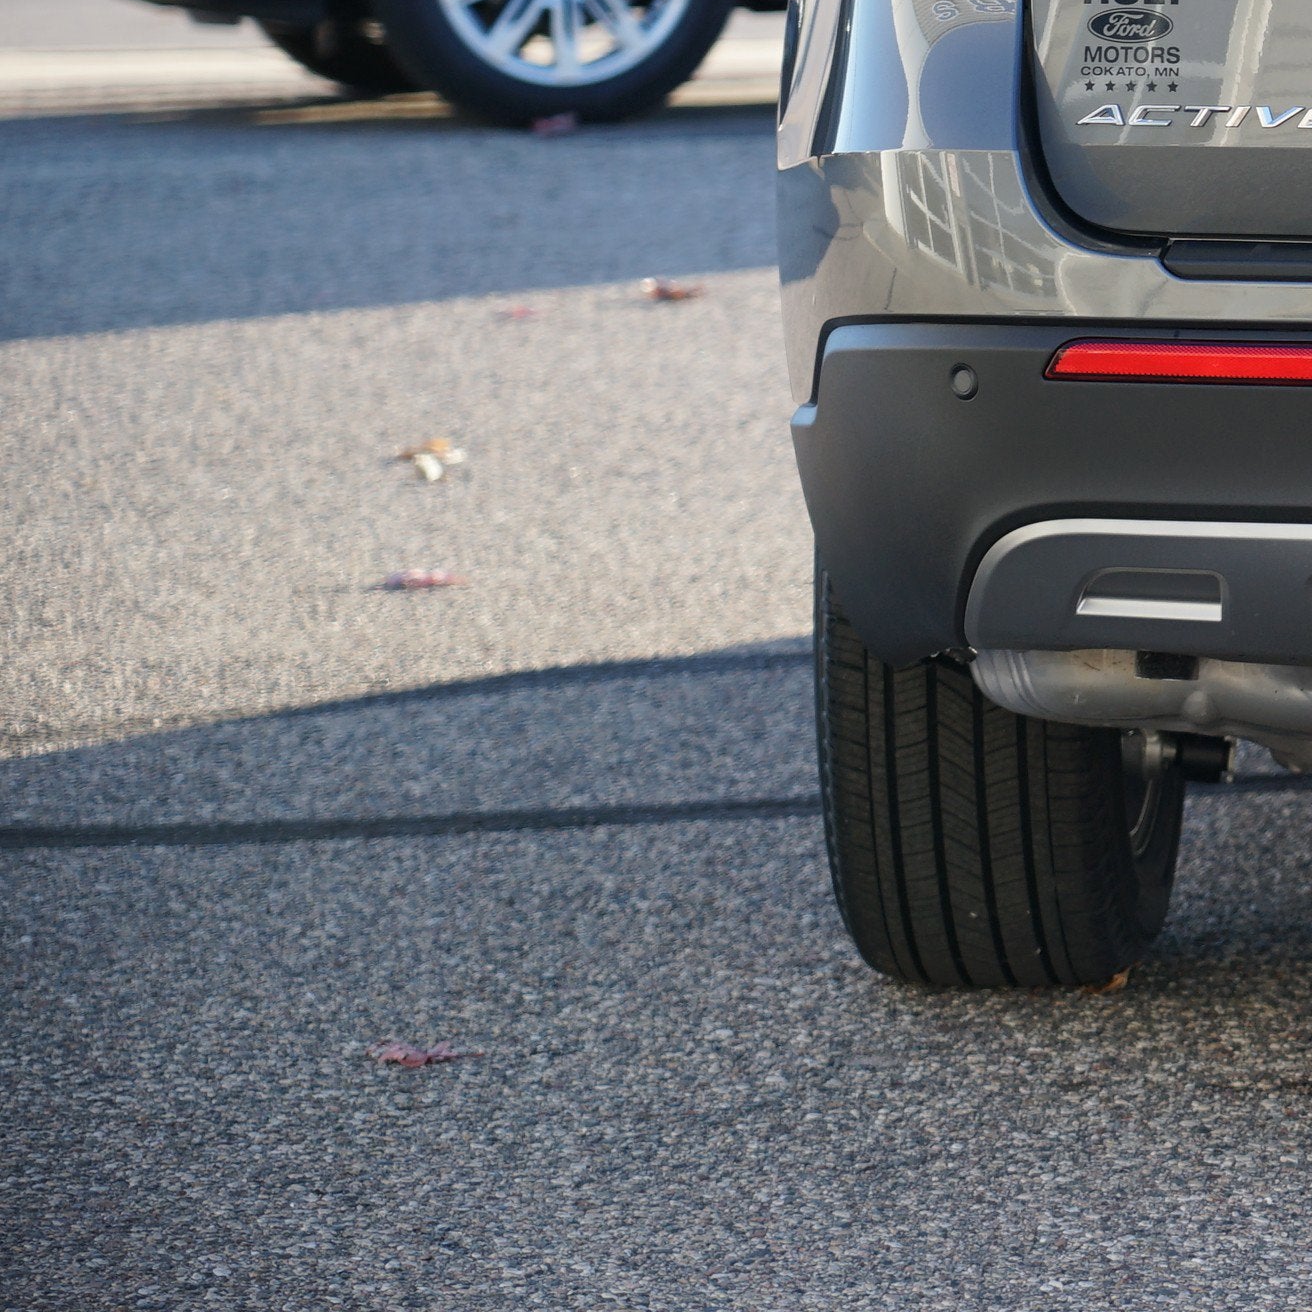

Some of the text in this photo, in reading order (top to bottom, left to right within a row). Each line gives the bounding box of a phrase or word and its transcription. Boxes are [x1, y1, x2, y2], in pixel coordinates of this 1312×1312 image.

[1103, 12, 1157, 37] Ford
[1084, 45, 1181, 64] MOTORS
[1080, 66, 1180, 79] COKATO, MN
